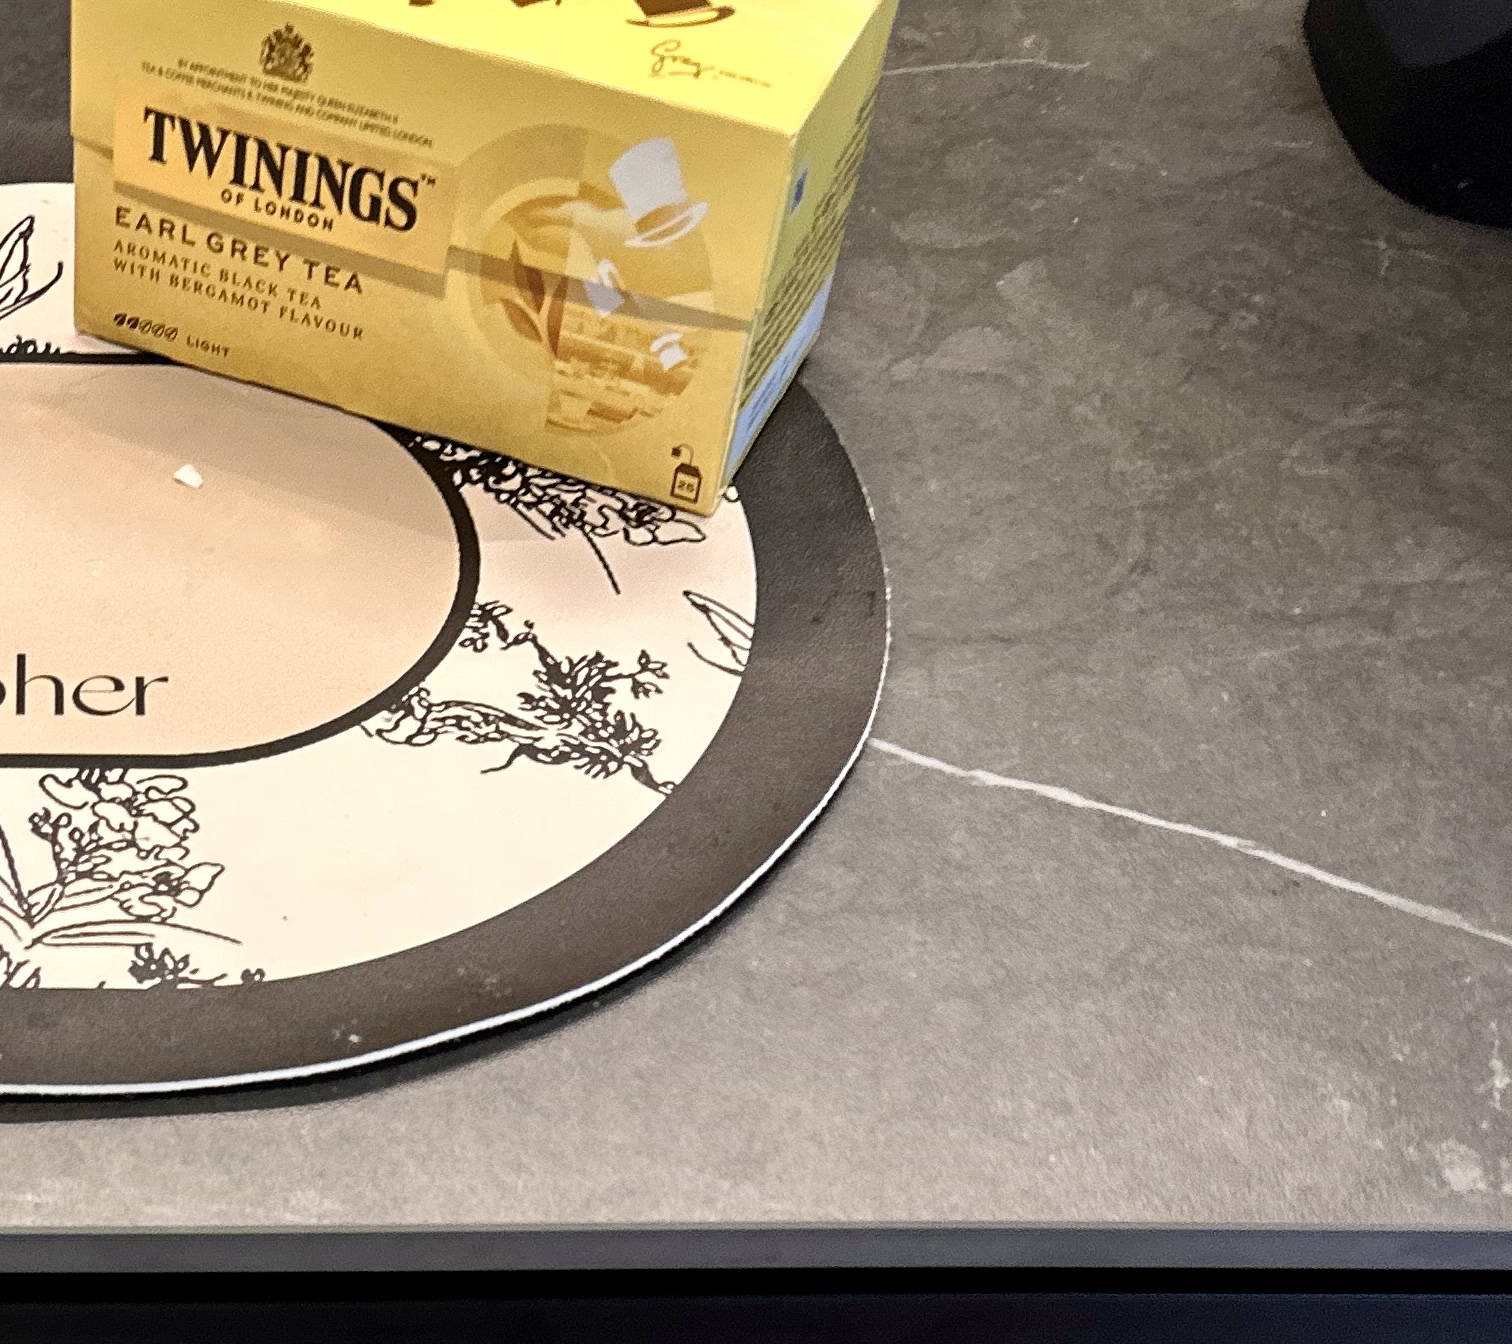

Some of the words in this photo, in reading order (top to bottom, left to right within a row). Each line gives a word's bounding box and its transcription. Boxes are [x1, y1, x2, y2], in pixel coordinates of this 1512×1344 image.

[143, 105, 419, 233] TWININGS
[221, 187, 245, 206] OF
[253, 196, 334, 232] LONDON
[114, 239, 211, 278] AROMATIC
[219, 268, 279, 298] BLACK
[288, 287, 322, 310] TEA
[115, 205, 196, 247] EARL
[206, 232, 290, 272] GREY
[302, 257, 363, 295] TEA
[113, 257, 162, 283] WITH
[169, 273, 271, 314] BERGAMOT
[279, 305, 364, 341] FLAVOUR
[186, 335, 231, 358] LIGHT
